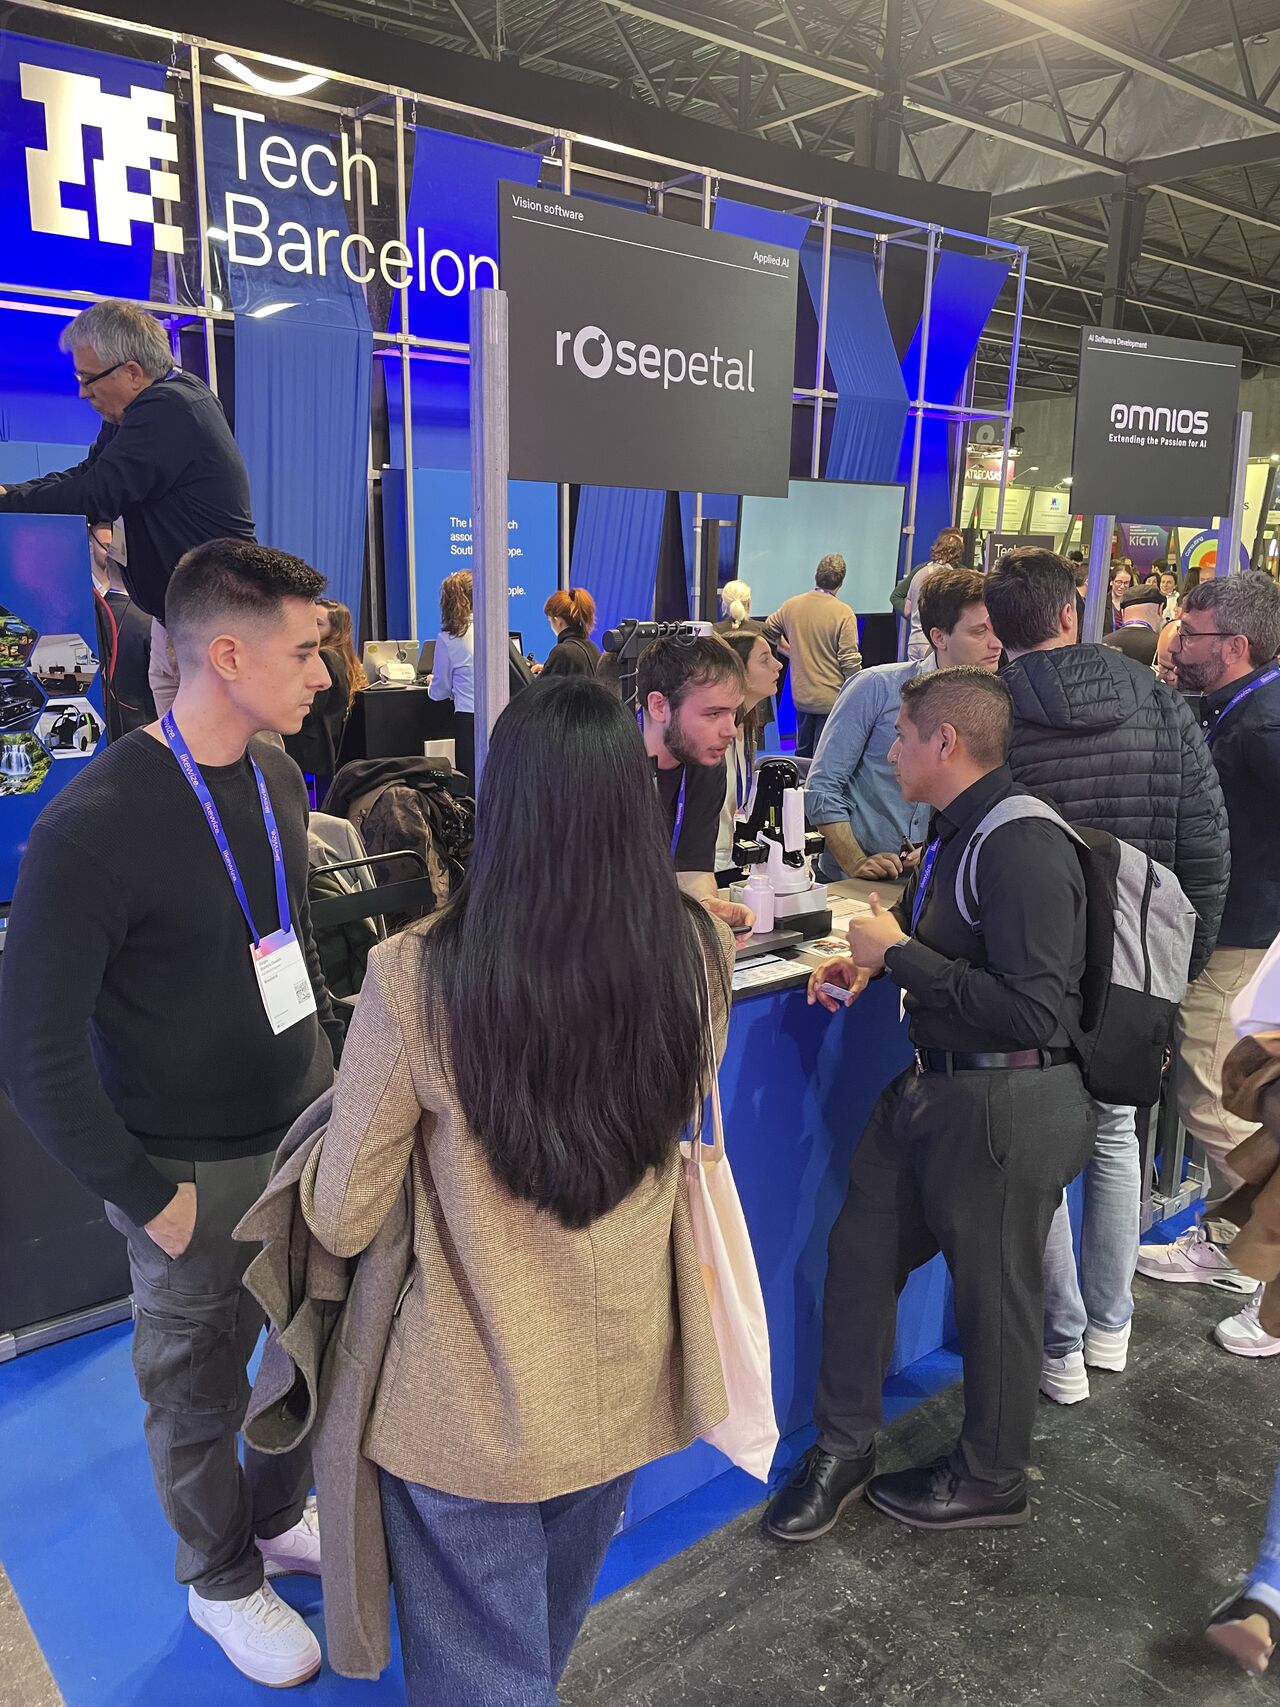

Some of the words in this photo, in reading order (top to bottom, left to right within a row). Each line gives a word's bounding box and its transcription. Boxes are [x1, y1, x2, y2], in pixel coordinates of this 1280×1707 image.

[213, 103, 379, 206] Tech
[512, 194, 542, 212] Vision
[543, 204, 584, 221] software
[224, 191, 499, 297] Barcelon
[753, 250, 780, 266] Applied
[781, 257, 790, 268] AI
[1088, 334, 1095, 342] AI
[1095, 334, 1116, 345] Software
[1117, 337, 1148, 349] Development
[556, 325, 755, 392] rosepetal
[1108, 433, 1145, 446] Extending
[1147, 436, 1159, 445] the
[1160, 437, 1187, 447] Passion
[1188, 439, 1198, 447] for
[1200, 440, 1207, 448] AI
[449, 517, 467, 528] The
[507, 520, 518, 529] ch
